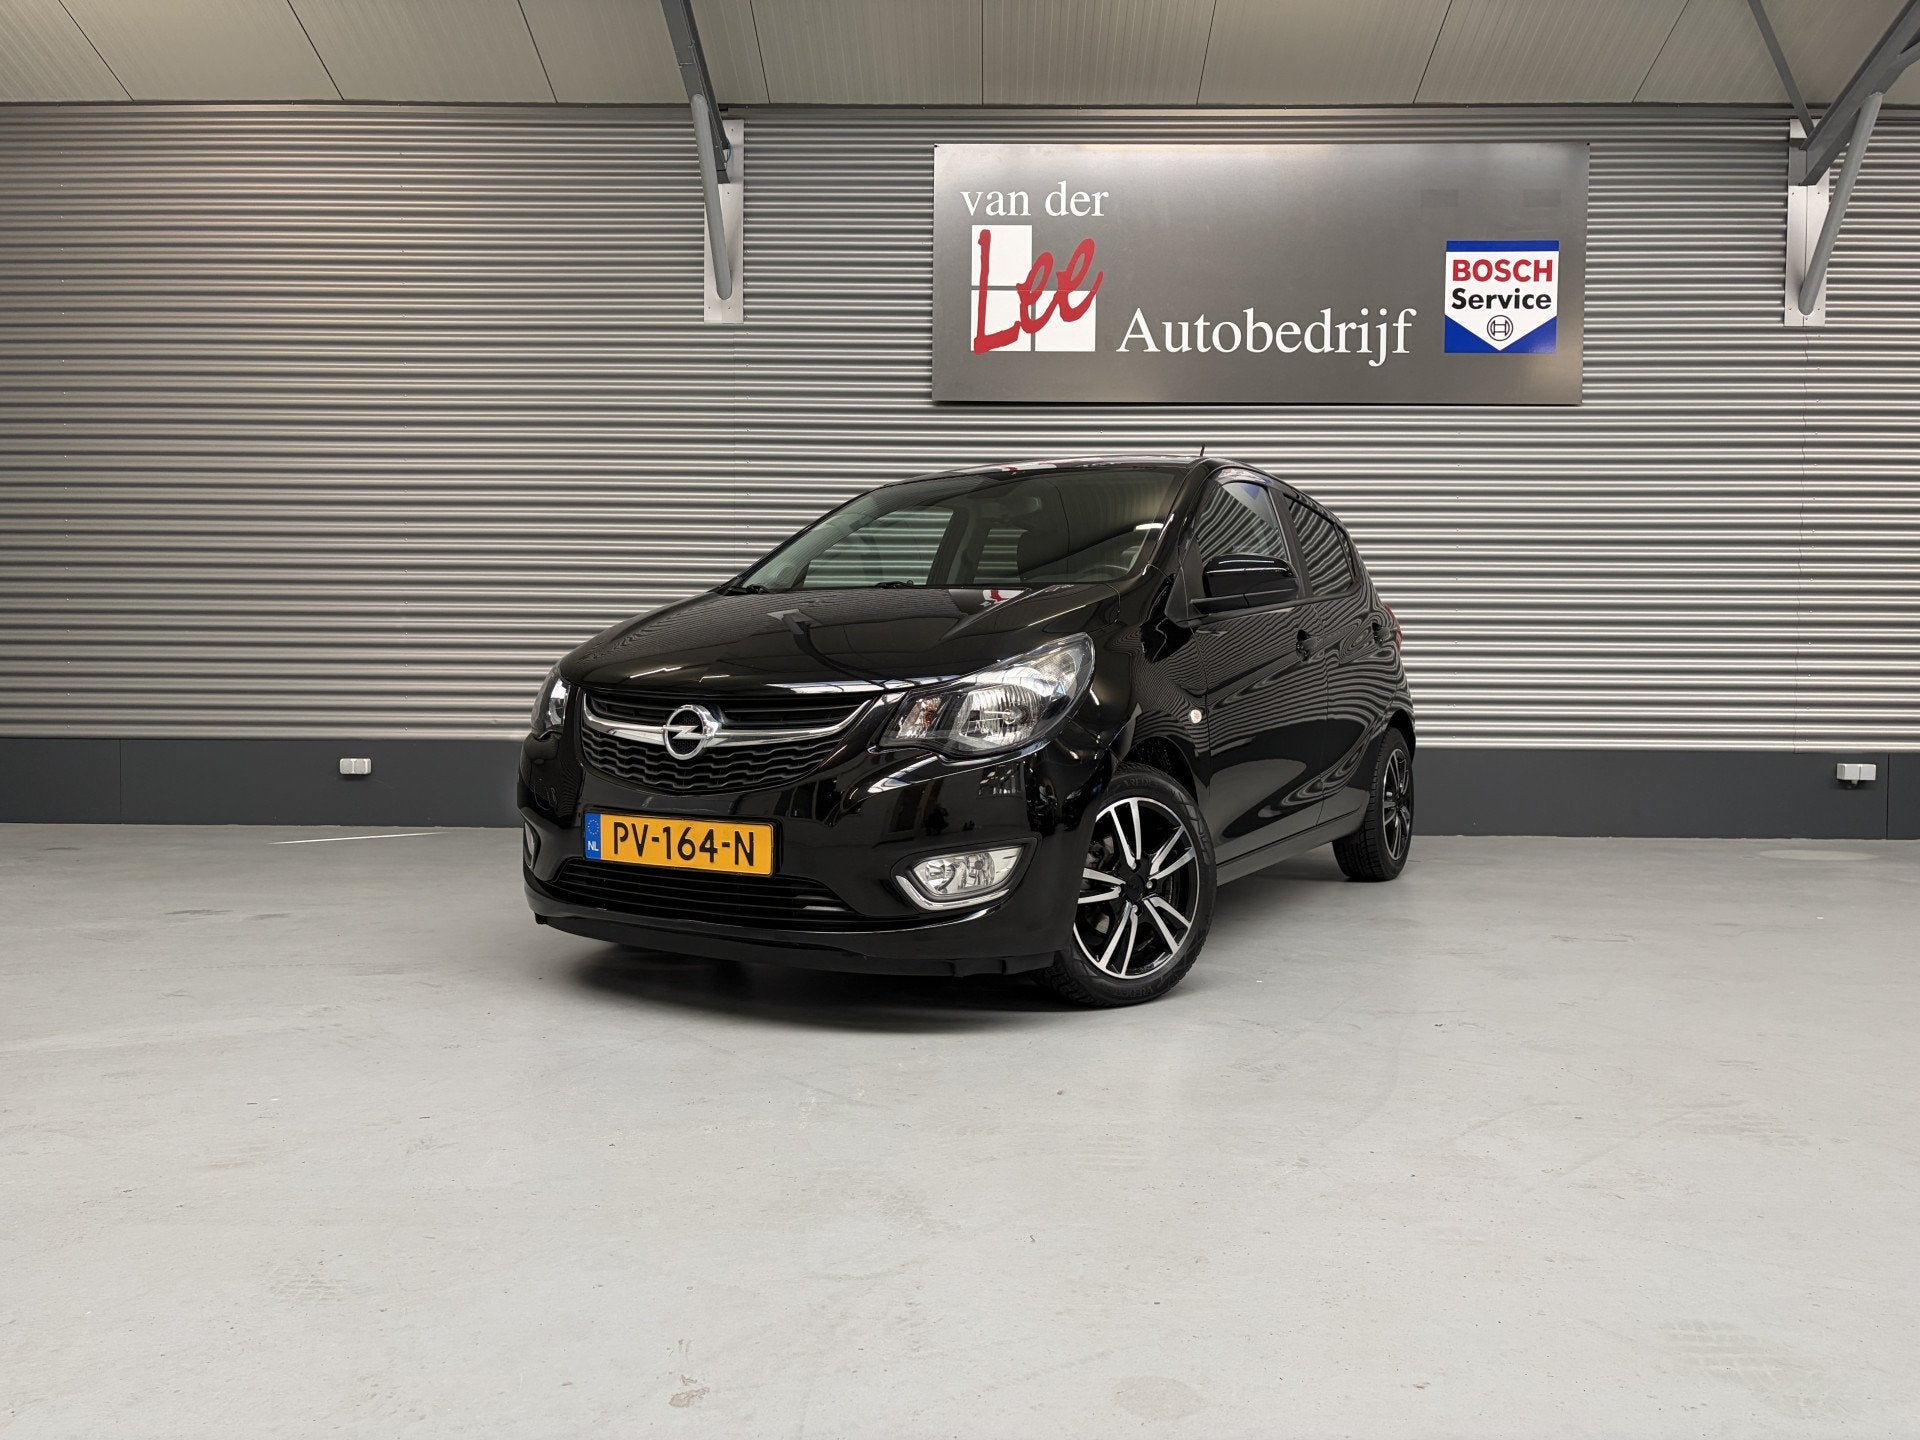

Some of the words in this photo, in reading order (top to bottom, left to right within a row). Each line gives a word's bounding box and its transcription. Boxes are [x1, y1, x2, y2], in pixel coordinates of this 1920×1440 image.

[960, 190, 1031, 217] van
[1045, 180, 1110, 217] der
[1452, 258, 1553, 283] BOSCH
[974, 229, 1104, 355] Lee
[1451, 287, 1552, 311] Service
[1116, 307, 1417, 367] Autobedrijf
[587, 840, 600, 852] NL
[613, 821, 754, 867] PV-164-N
